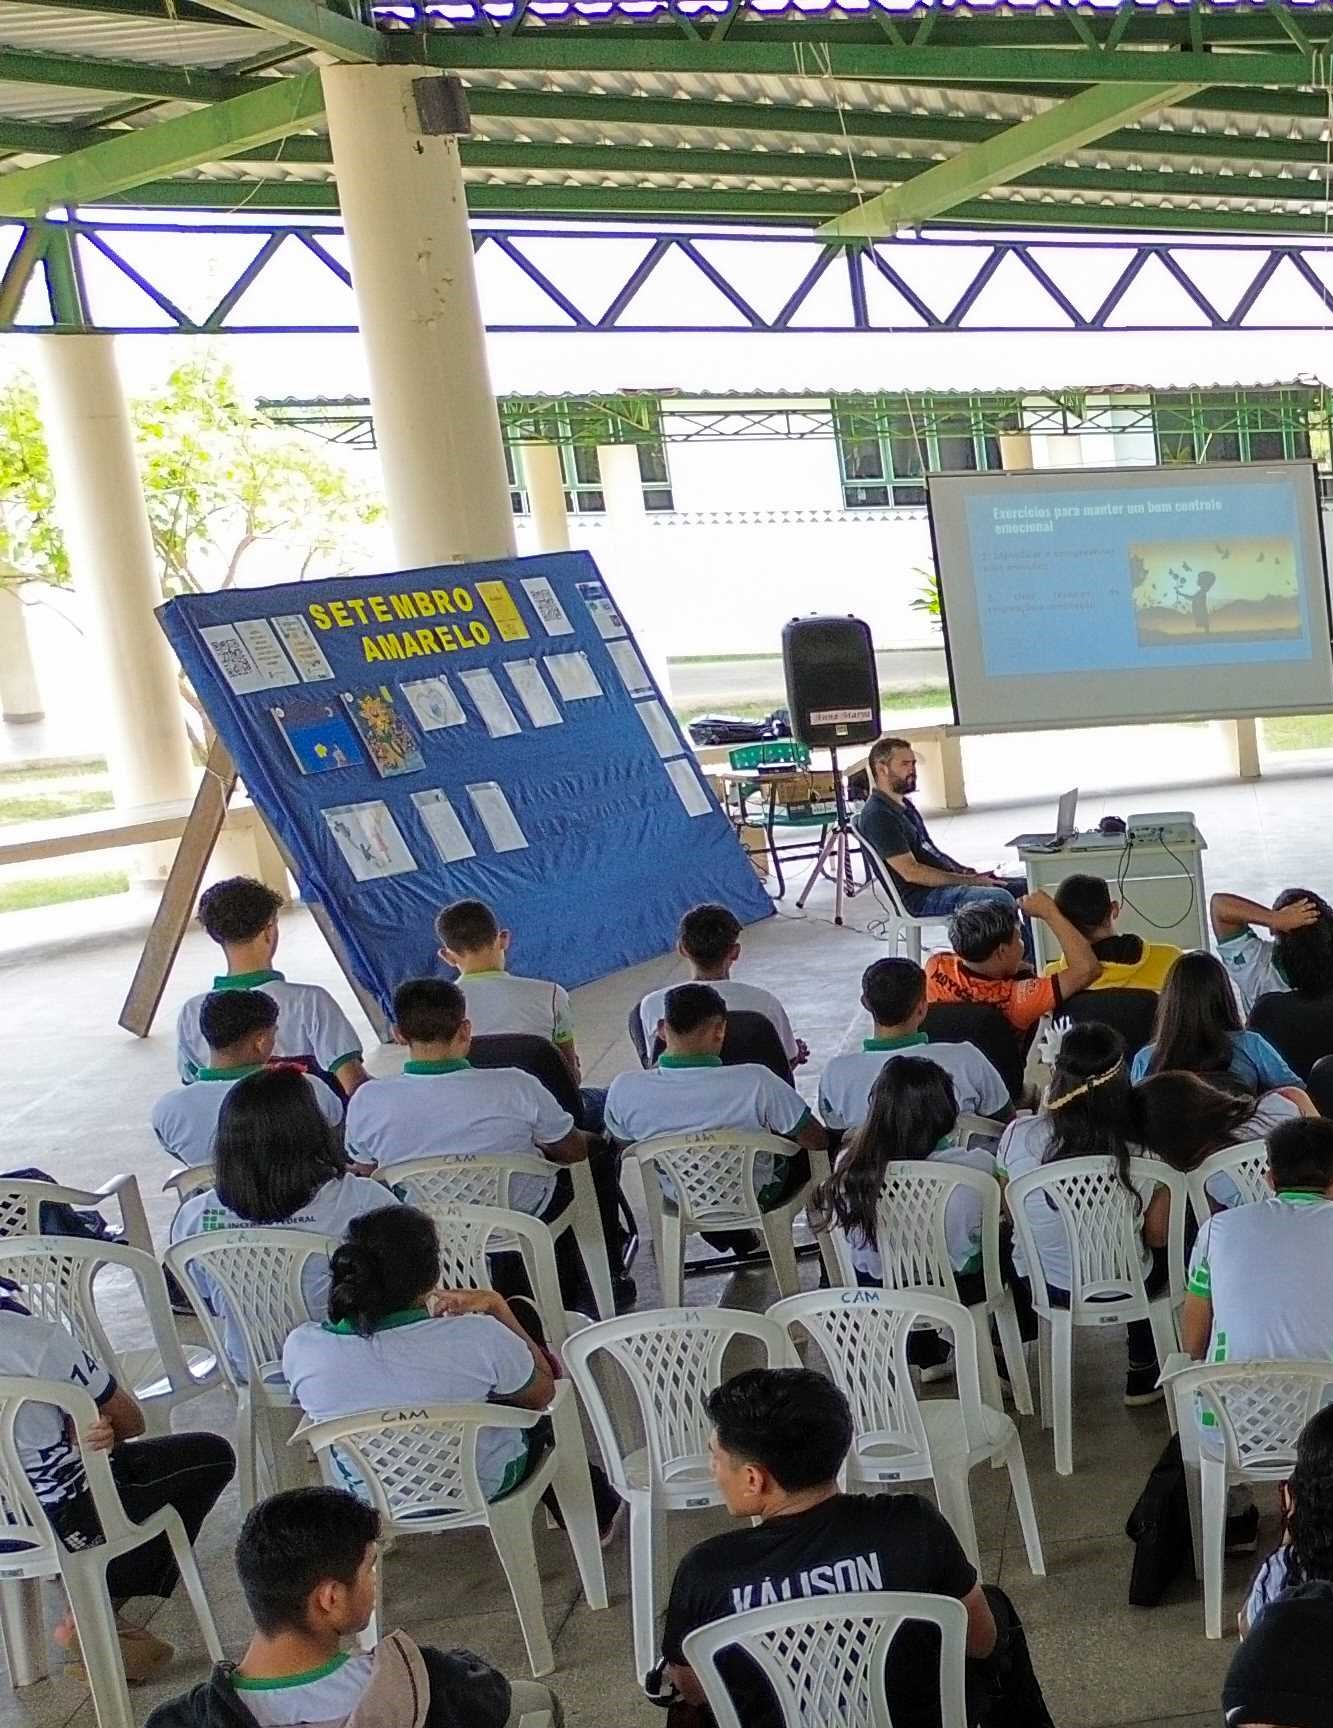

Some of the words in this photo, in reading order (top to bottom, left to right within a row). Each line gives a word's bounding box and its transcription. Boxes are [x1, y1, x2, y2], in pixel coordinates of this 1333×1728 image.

[308, 587, 474, 630] SETEMBRO
[361, 621, 491, 662] AMARELO
[839, 1290, 880, 1305] CAM
[71, 1350, 99, 1386] 14
[381, 1408, 429, 1423] CAM
